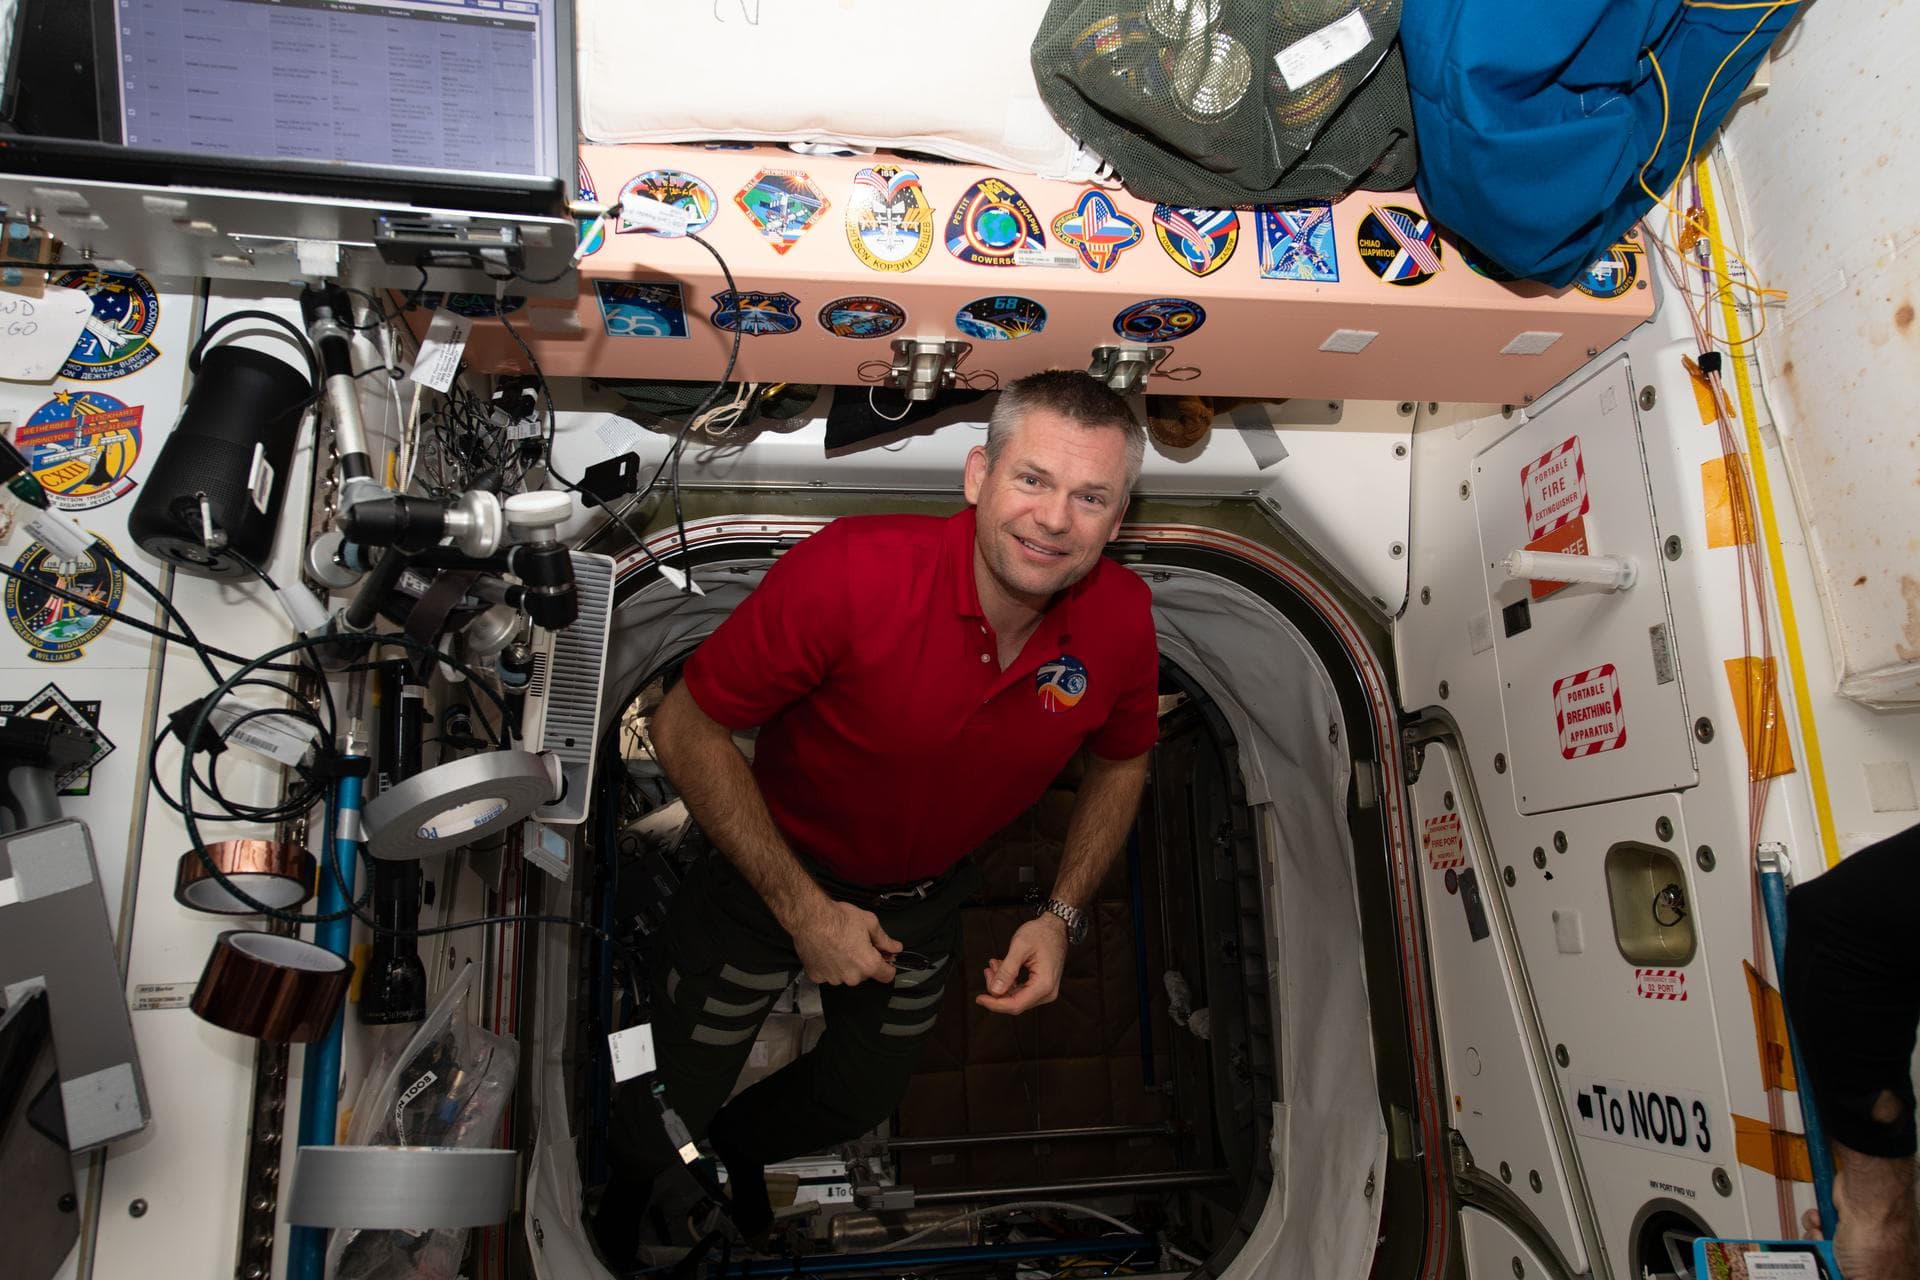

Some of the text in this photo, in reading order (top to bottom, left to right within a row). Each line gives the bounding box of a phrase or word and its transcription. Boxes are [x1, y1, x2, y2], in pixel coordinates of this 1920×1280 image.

[1360, 239, 1381, 248] CHIAO
[1360, 248, 1396, 258] ШАРИПОВ
[994, 297, 1018, 310] 68
[606, 308, 662, 338] 65
[40, 462, 88, 487] CXIII
[1534, 457, 1569, 484] PORTABLE
[1541, 476, 1567, 501] FIRE
[1535, 491, 1578, 521] EXTINGUISHER
[35, 651, 77, 660] WILLIAMS
[1567, 683, 1605, 703] PORTABLE
[1566, 701, 1612, 725] BREATHING
[1570, 722, 1614, 743] APPARATUS
[1431, 836, 1457, 848] FIRE PORT
[1657, 984, 1674, 992] PORT
[404, 1075, 432, 1099] 1008
[1592, 1084, 1711, 1153] To NOD 3
[835, 1187, 848, 1197] To
